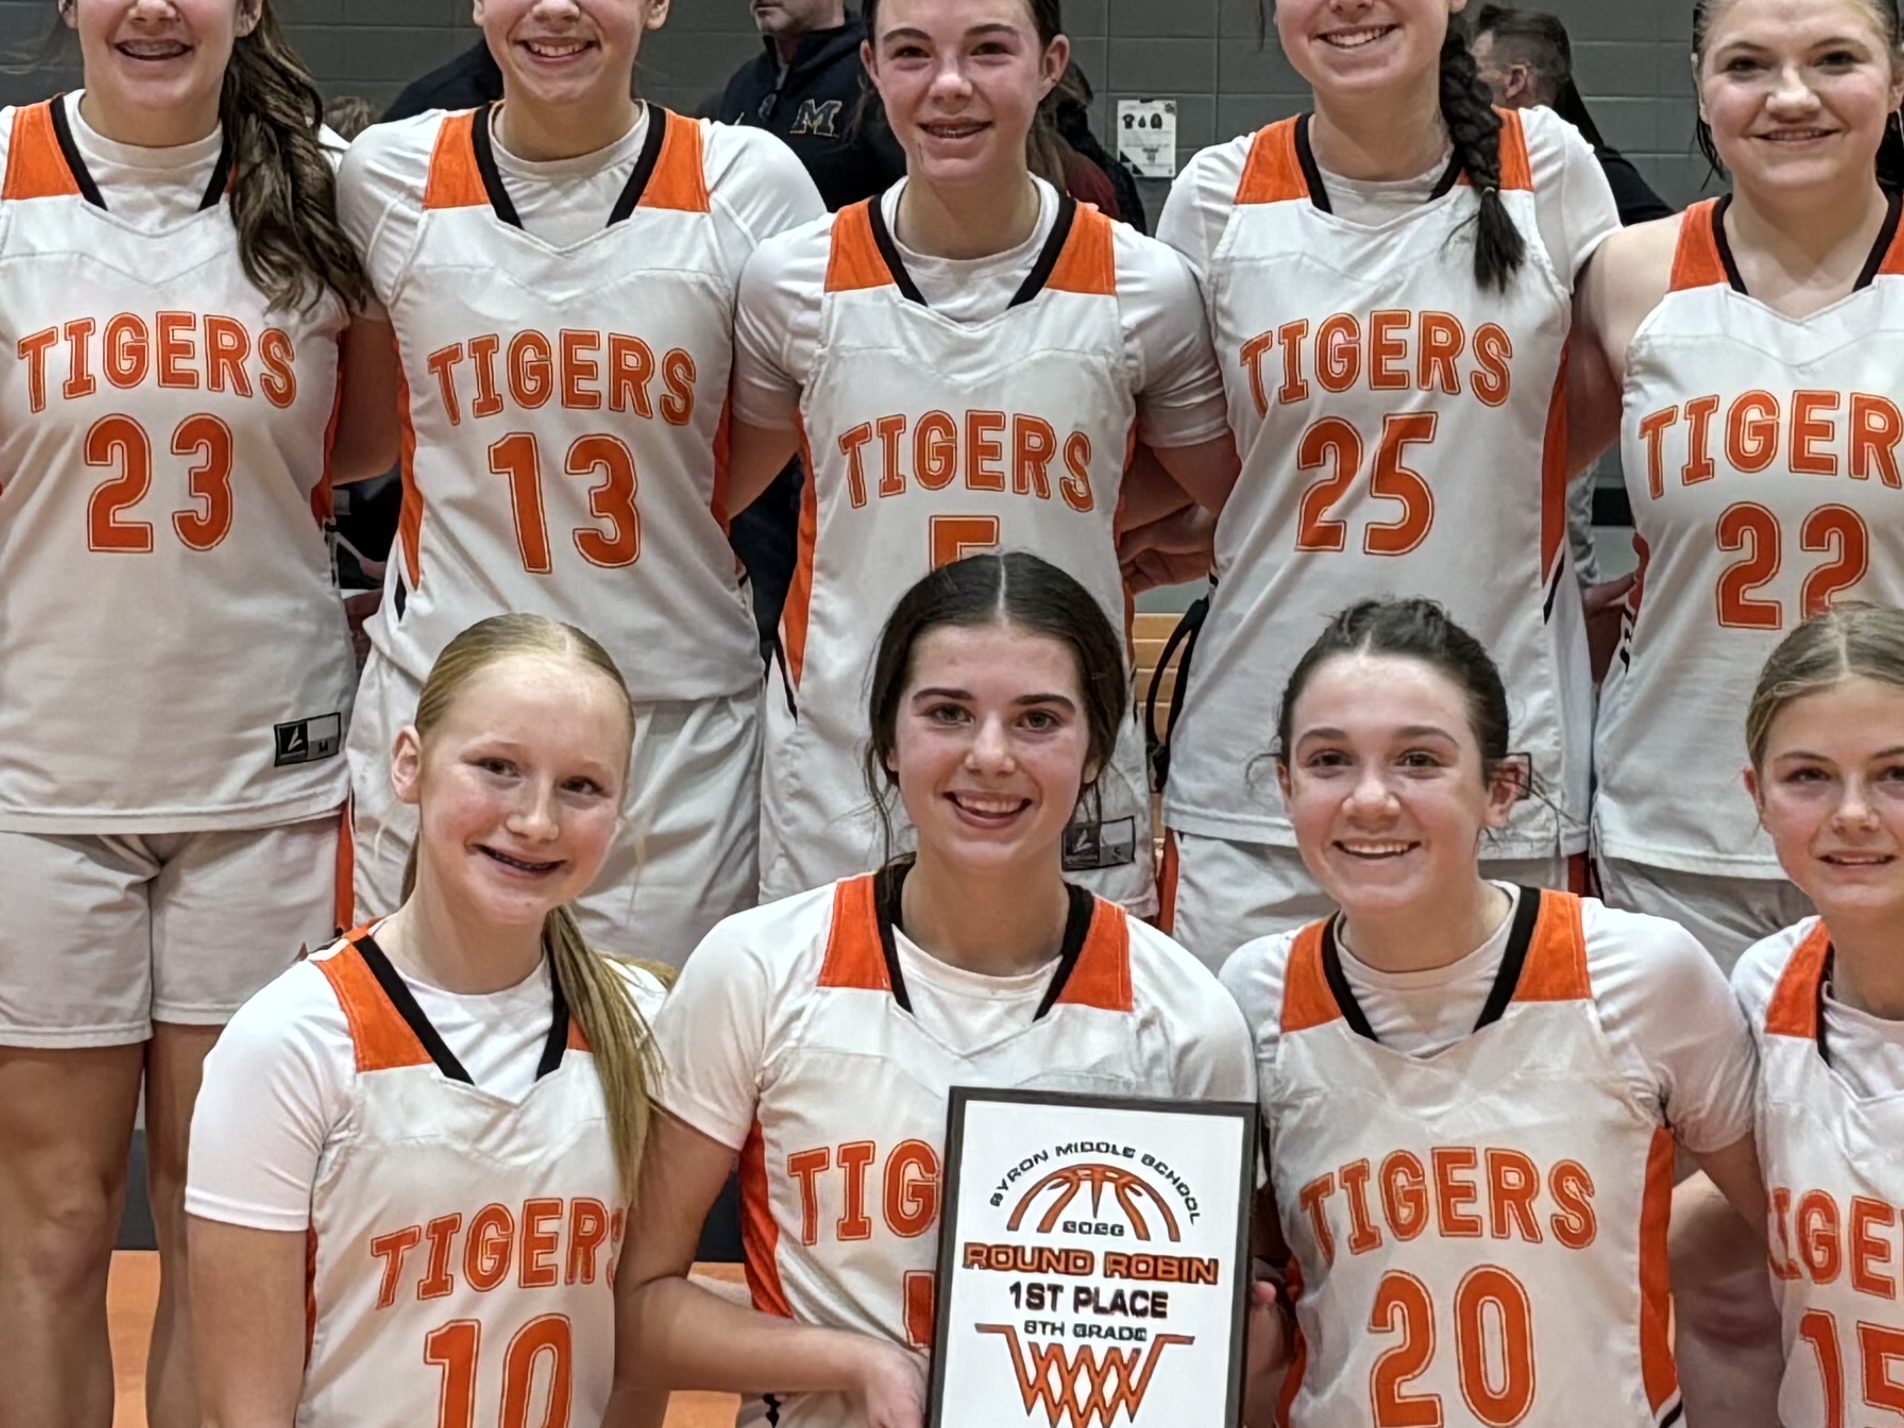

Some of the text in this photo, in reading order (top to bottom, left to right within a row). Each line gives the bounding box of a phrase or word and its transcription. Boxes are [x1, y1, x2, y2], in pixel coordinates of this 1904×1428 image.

[789, 99, 843, 138] M
[17, 310, 296, 413] TIGERS
[427, 329, 696, 426] TIGERS
[1240, 309, 1513, 420] TIGERS
[85, 413, 233, 553] 23
[488, 432, 640, 574] 13
[838, 410, 1094, 513] TIGERS
[1296, 412, 1438, 555] 25
[1716, 501, 1868, 629] 22
[788, 1139, 942, 1247] TIG
[990, 1141, 1200, 1225] BYRON MIDDLE SCHOOL
[1300, 1147, 1597, 1269] TIGERS
[963, 1242, 1219, 1285] ROUND ROBIN
[1009, 1281, 1169, 1319] 1ST PLACE
[1072, 1323, 1147, 1342] GRADE
